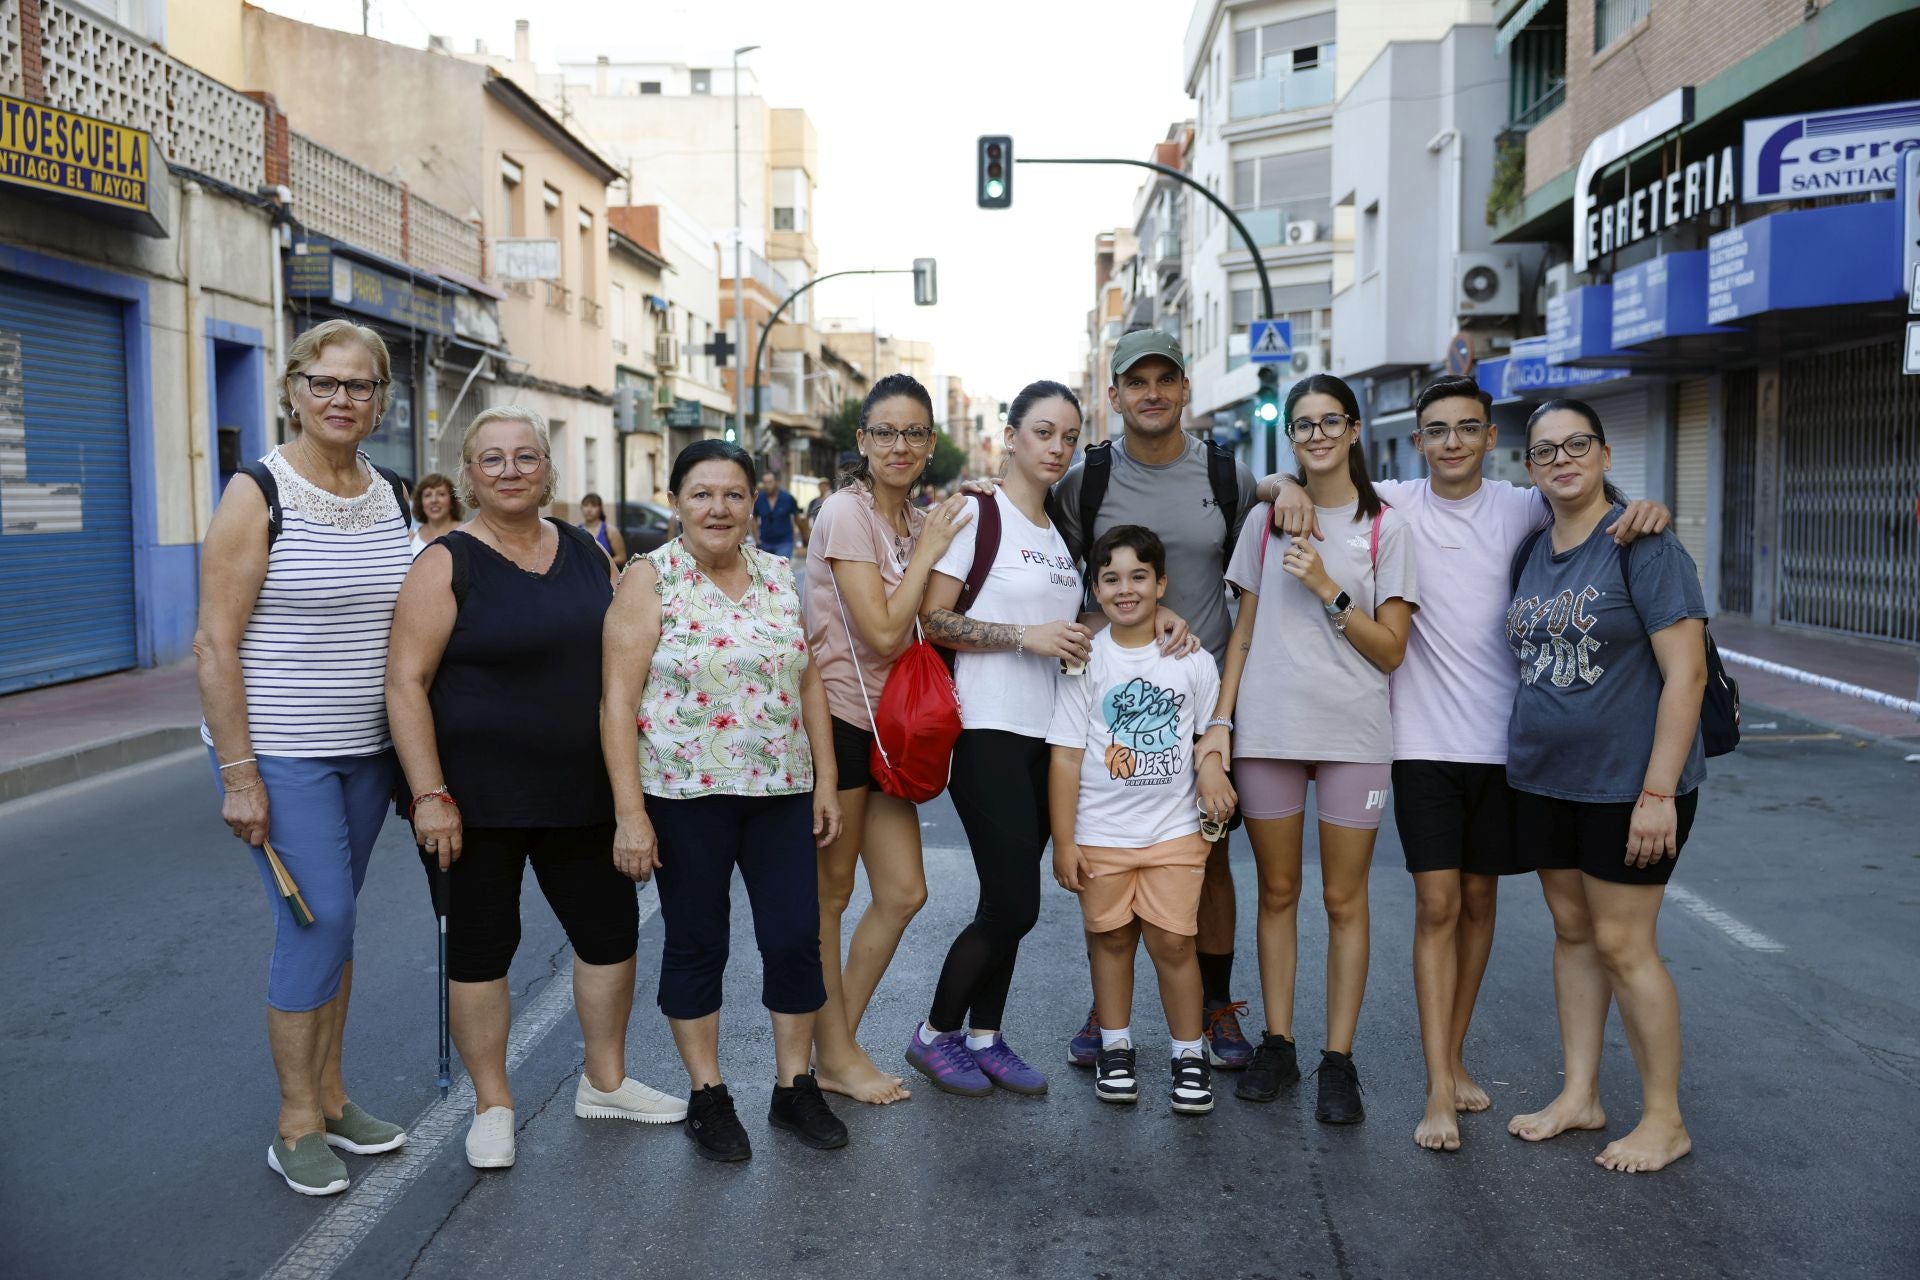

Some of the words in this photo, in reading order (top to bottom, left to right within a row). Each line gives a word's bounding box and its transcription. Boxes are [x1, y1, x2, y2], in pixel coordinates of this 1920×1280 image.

[0, 101, 143, 177] TOESCUELA
[66, 166, 85, 190] EL
[91, 171, 142, 202] MAYOR
[1791, 164, 1897, 191] SANTIAG
[1021, 549, 1054, 567] PEPE
[1050, 572, 1077, 588] LONDON
[1365, 790, 1388, 810] PU
